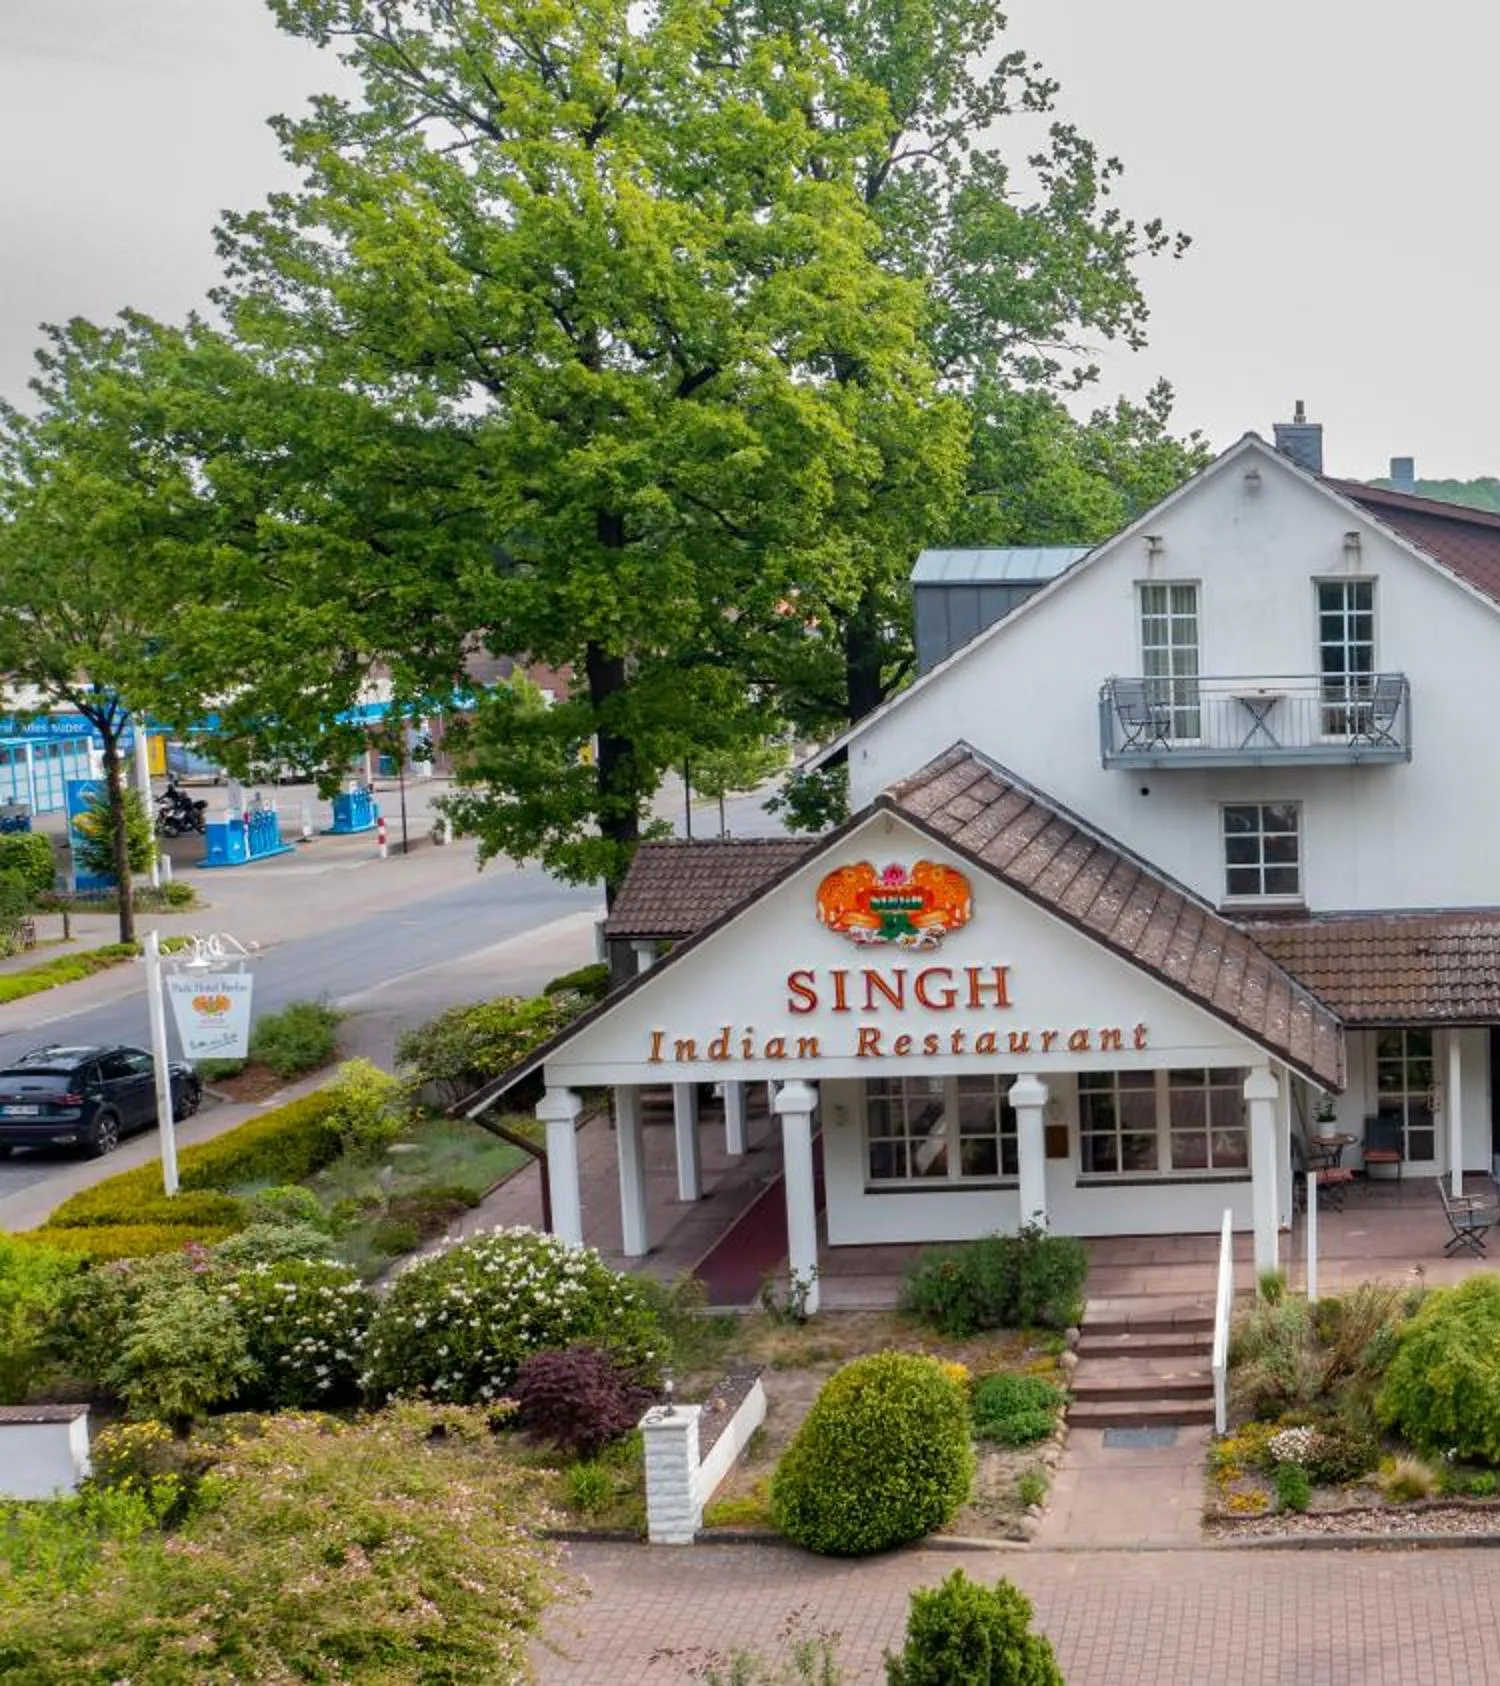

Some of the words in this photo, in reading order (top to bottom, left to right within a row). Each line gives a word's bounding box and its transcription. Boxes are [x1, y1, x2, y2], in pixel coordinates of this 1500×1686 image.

[787, 966, 1011, 1013] SINGH
[648, 1026, 820, 1063] Indian
[856, 1022, 1149, 1059] Restaurant
